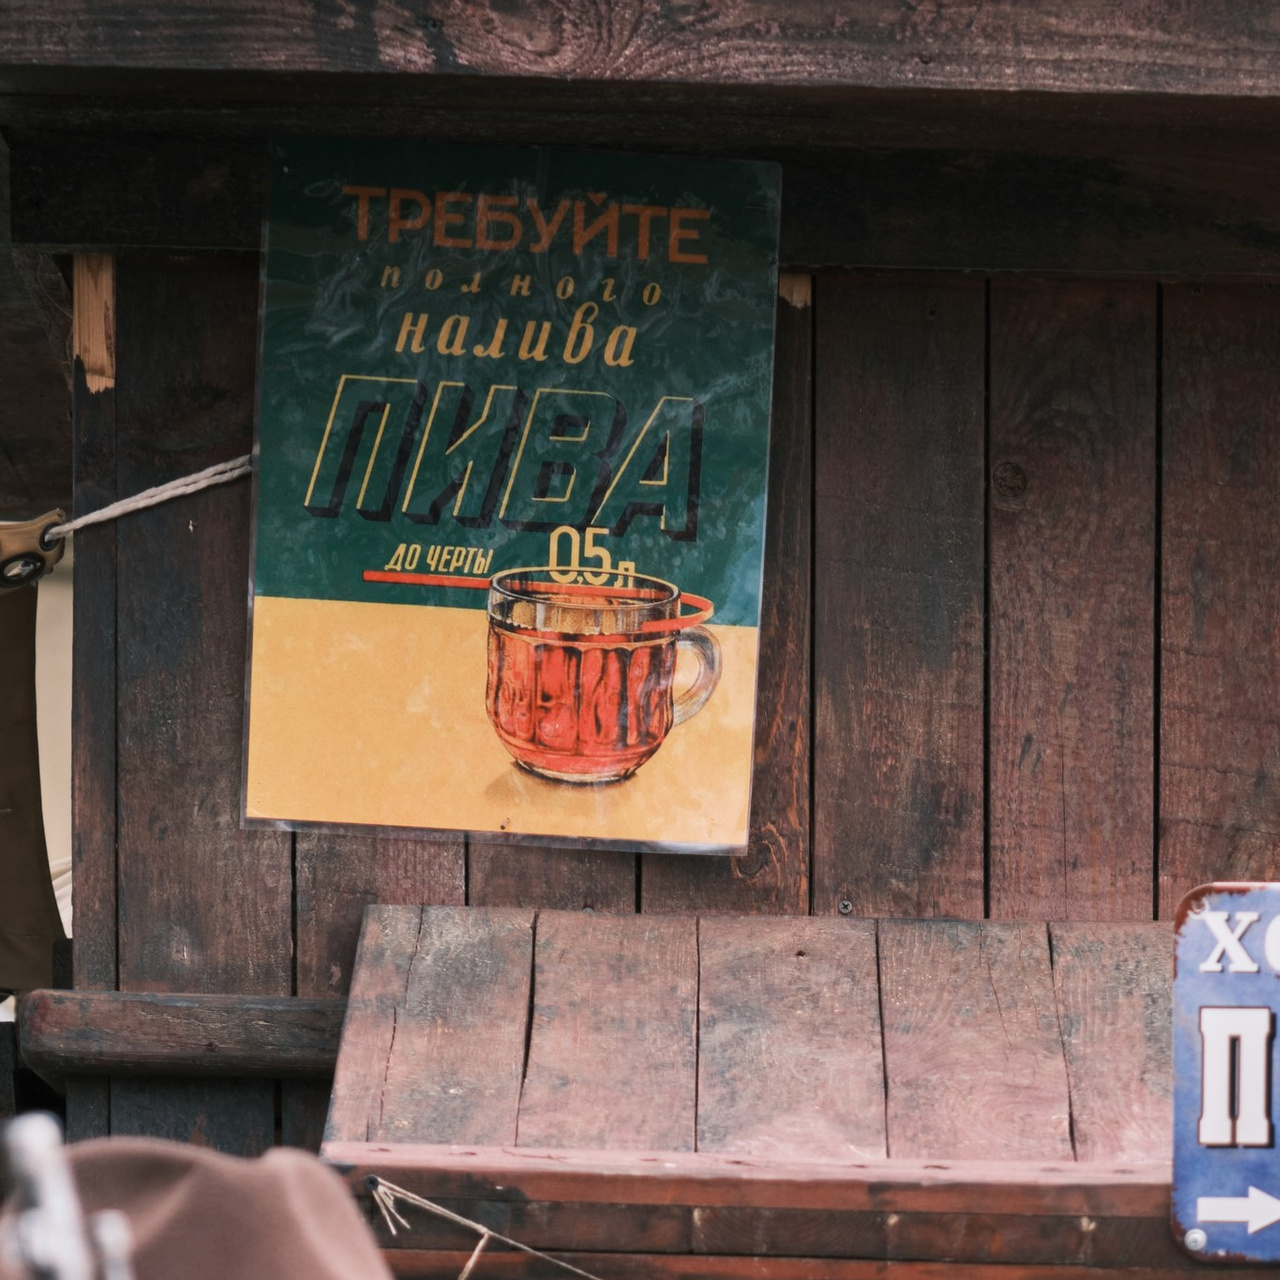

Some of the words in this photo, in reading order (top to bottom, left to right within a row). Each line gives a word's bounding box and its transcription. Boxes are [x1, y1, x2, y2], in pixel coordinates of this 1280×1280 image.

[341, 184, 711, 264] ТРЕБУЙТЕ
[380, 264, 661, 306] полного
[394, 301, 637, 368] налива
[303, 374, 706, 542] ПИВА
[384, 543, 421, 572] ДО
[426, 544, 494, 575] ЧЕРТЫ
